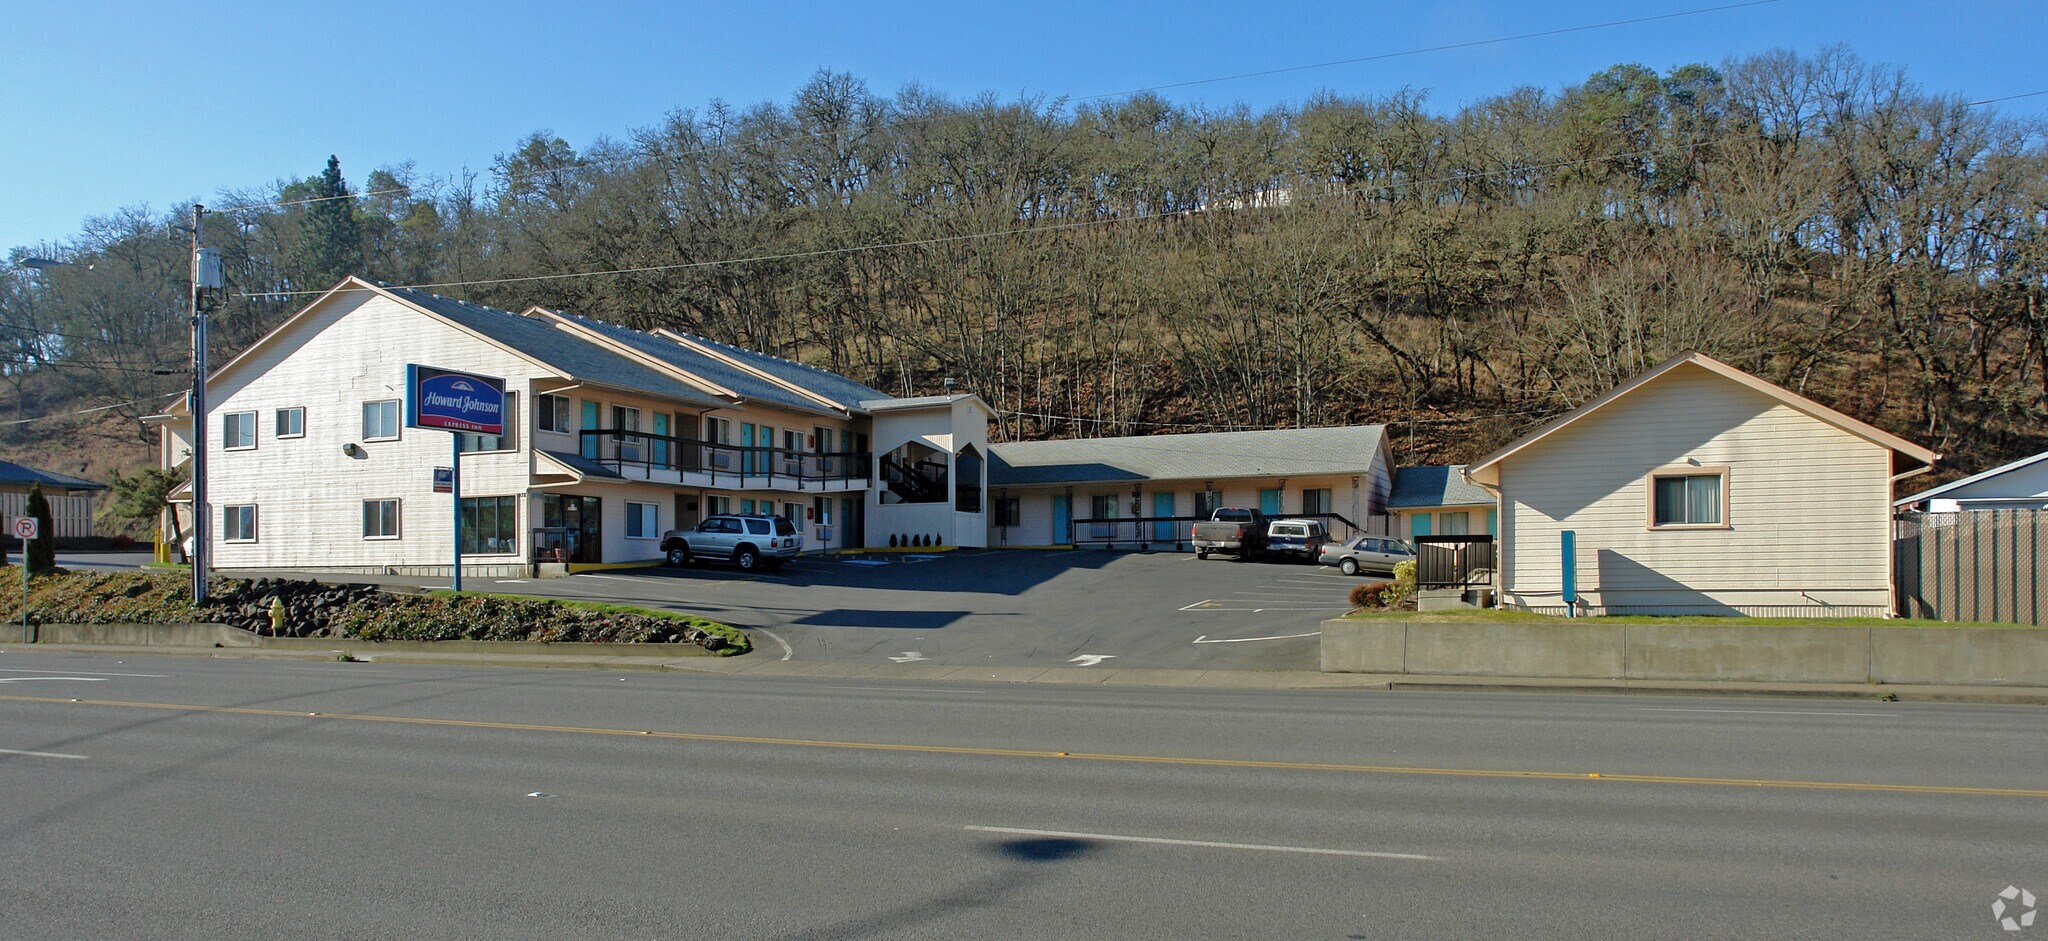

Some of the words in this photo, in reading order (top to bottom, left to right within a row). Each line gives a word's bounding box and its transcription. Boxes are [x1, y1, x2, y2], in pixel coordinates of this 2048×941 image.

[424, 392, 462, 408] Howard
[462, 396, 499, 413] Johnson
[444, 421, 469, 429] EXPRESS
[21, 522, 32, 534] P
